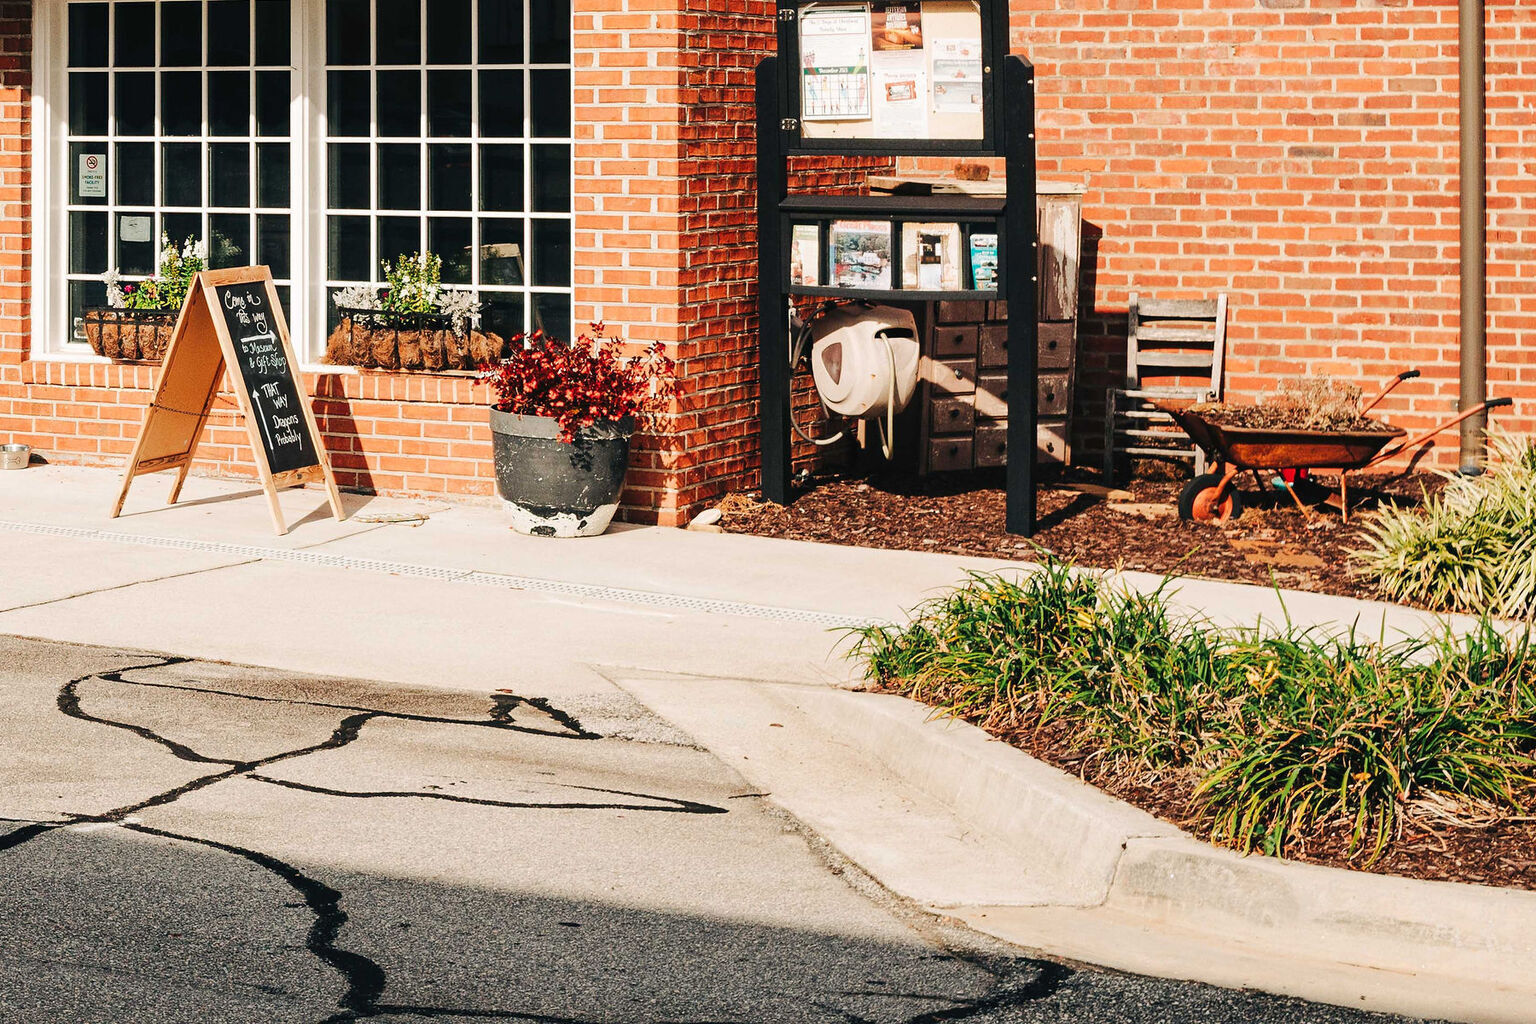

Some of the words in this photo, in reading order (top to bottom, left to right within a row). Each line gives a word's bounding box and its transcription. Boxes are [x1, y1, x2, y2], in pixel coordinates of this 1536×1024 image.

[224, 290, 246, 309] Come
[247, 291, 261, 305] in
[261, 381, 279, 398] THAT
[273, 393, 288, 409] WAY
[272, 415, 299, 433] Dragons
[275, 429, 302, 451] Probably
